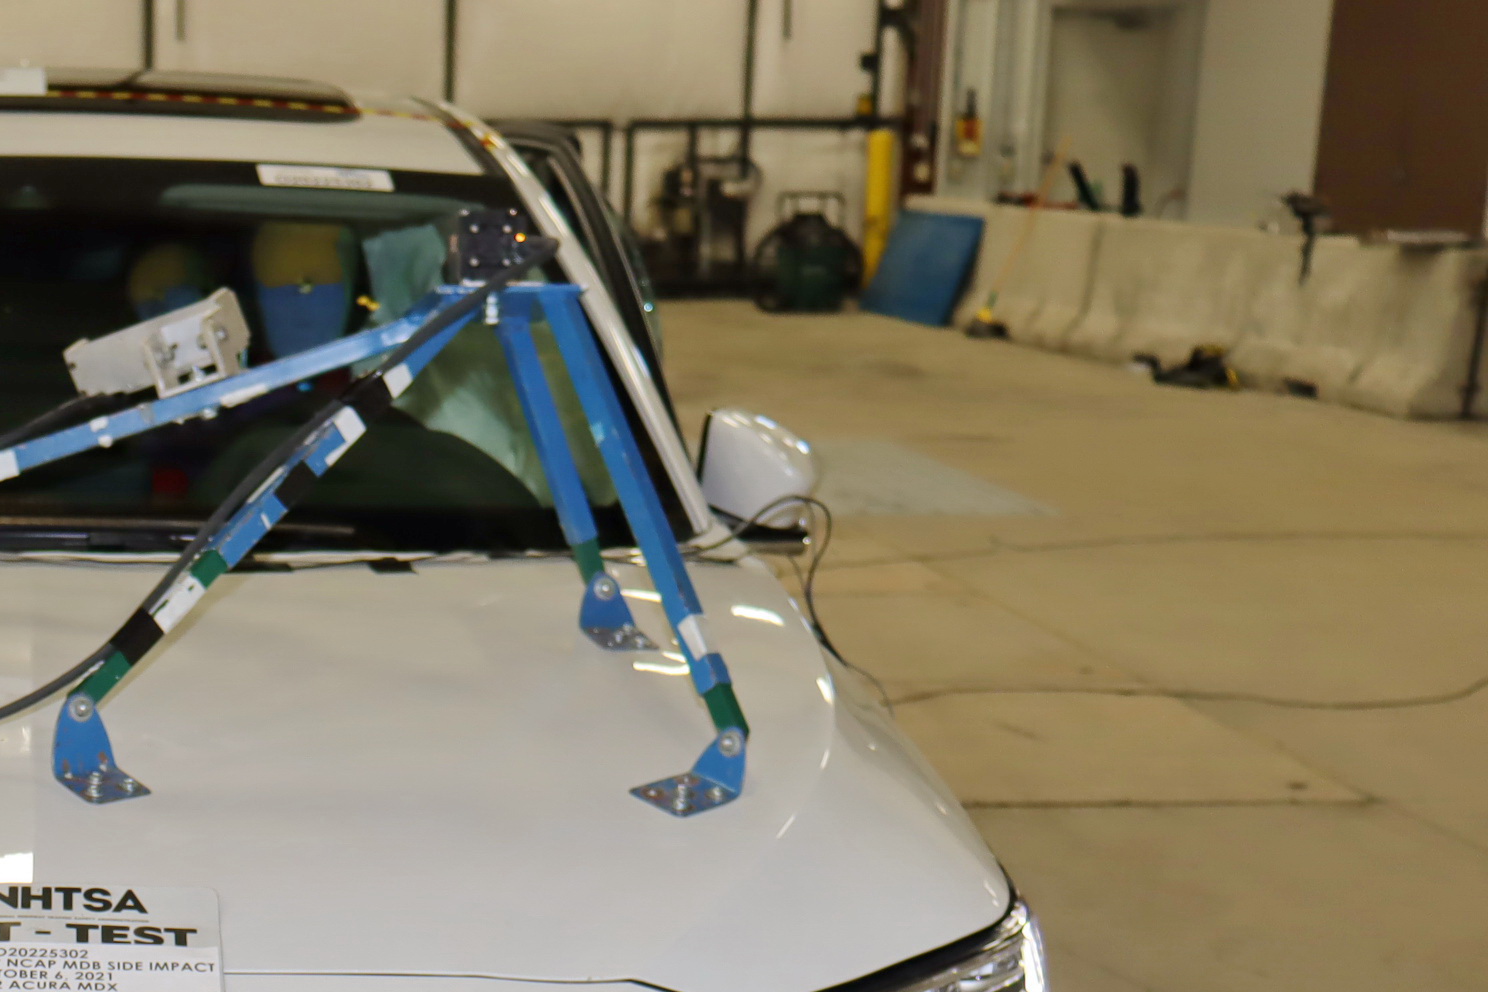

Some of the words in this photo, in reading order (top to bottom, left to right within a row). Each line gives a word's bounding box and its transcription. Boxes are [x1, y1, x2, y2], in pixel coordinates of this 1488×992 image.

[65, 923, 198, 947] TEST
[6, 958, 56, 969] NCAP
[63, 960, 101, 970] MDB
[107, 961, 143, 971] SIDE
[149, 961, 215, 973] IMPACT
[75, 971, 113, 981] 2021
[9, 980, 71, 991] ACURA
[77, 982, 118, 992] MDX
